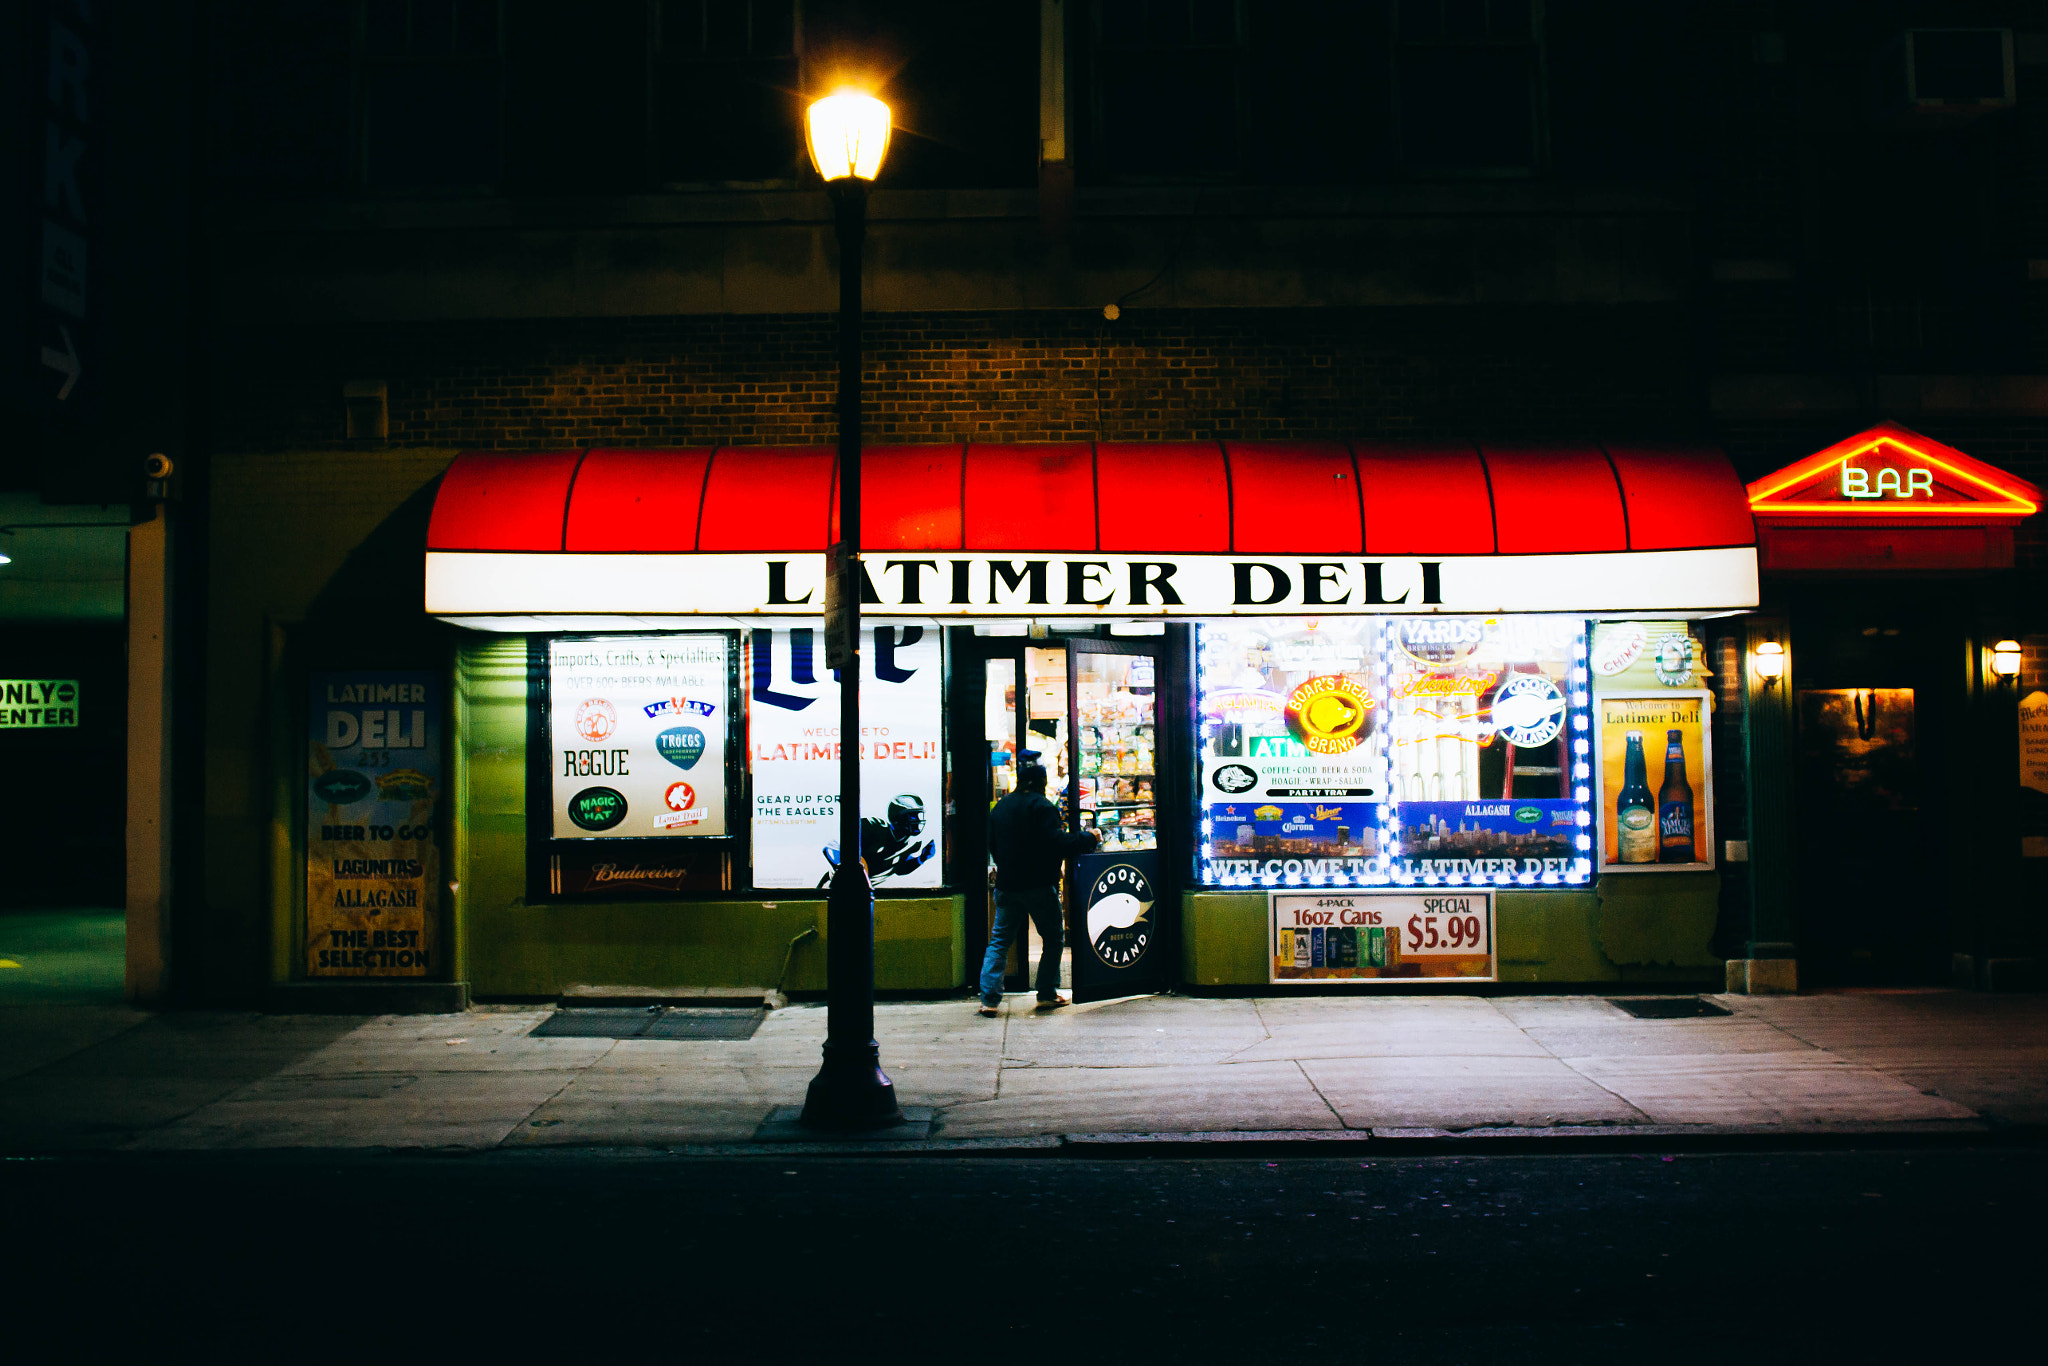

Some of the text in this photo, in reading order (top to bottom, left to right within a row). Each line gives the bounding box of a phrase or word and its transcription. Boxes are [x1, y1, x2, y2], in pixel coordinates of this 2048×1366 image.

[1842, 459, 1933, 498] BAR
[1230, 560, 1444, 606] DELI
[1404, 619, 1482, 643] YARDS
[554, 651, 602, 671] Imports,
[647, 650, 655, 665] &
[659, 647, 721, 669] Specialties
[1603, 633, 1642, 672] CHIMAY
[567, 678, 591, 689] OVER
[622, 676, 650, 688] BEERS
[655, 675, 705, 687] AVAILABLE
[1394, 672, 1498, 699] Yuengling
[1507, 679, 1553, 697] GOOSE
[327, 683, 426, 703] LATIMER
[1288, 677, 1377, 711] BOAR'S HEAD
[1625, 701, 1668, 710] Welcome
[0, 709, 74, 724] ENTER
[1606, 711, 1700, 723] Latimer Deli
[327, 710, 425, 748] DELI
[803, 728, 890, 737] WELCE TO
[1510, 722, 1558, 745] ISLAND
[874, 742, 936, 760] DELI!
[1256, 737, 1305, 757] ATM
[1309, 736, 1358, 755] BRAND
[358, 752, 391, 767] 255
[564, 750, 629, 777] ROGUE
[1261, 766, 1290, 774] COFFEE
[1297, 766, 1318, 774] COLD
[1351, 765, 1373, 773] SODA
[1271, 777, 1364, 786] HOAGIE WRAP SALAD
[757, 795, 841, 804] GEAR UP FOR
[1288, 788, 1348, 797] PARTY TRAY
[580, 797, 616, 811] MAGIC
[757, 807, 835, 816] THE EAGLES
[1465, 804, 1511, 816] ALLAGASH
[584, 810, 612, 821] HAT
[320, 824, 429, 841] BEER TO GO
[1282, 822, 1314, 833] Corona
[334, 860, 418, 874] LAGUNITAS
[592, 862, 687, 882] Budweiser
[1209, 859, 1381, 878] WELCOME TO
[1402, 858, 1518, 878] LATIMER
[1098, 868, 1145, 894] GOOSE
[334, 888, 418, 907] ALLAGASH
[1316, 899, 1355, 908] 4-PACK
[1423, 898, 1472, 914] SPECIAL
[1293, 908, 1383, 926] 16oz Cans
[330, 930, 419, 948] THE BEST
[1407, 913, 1481, 952] $5.99
[1098, 934, 1147, 963] ISLAND
[1316, 932, 1324, 962] ULTRA
[318, 950, 431, 968] SELECTION
